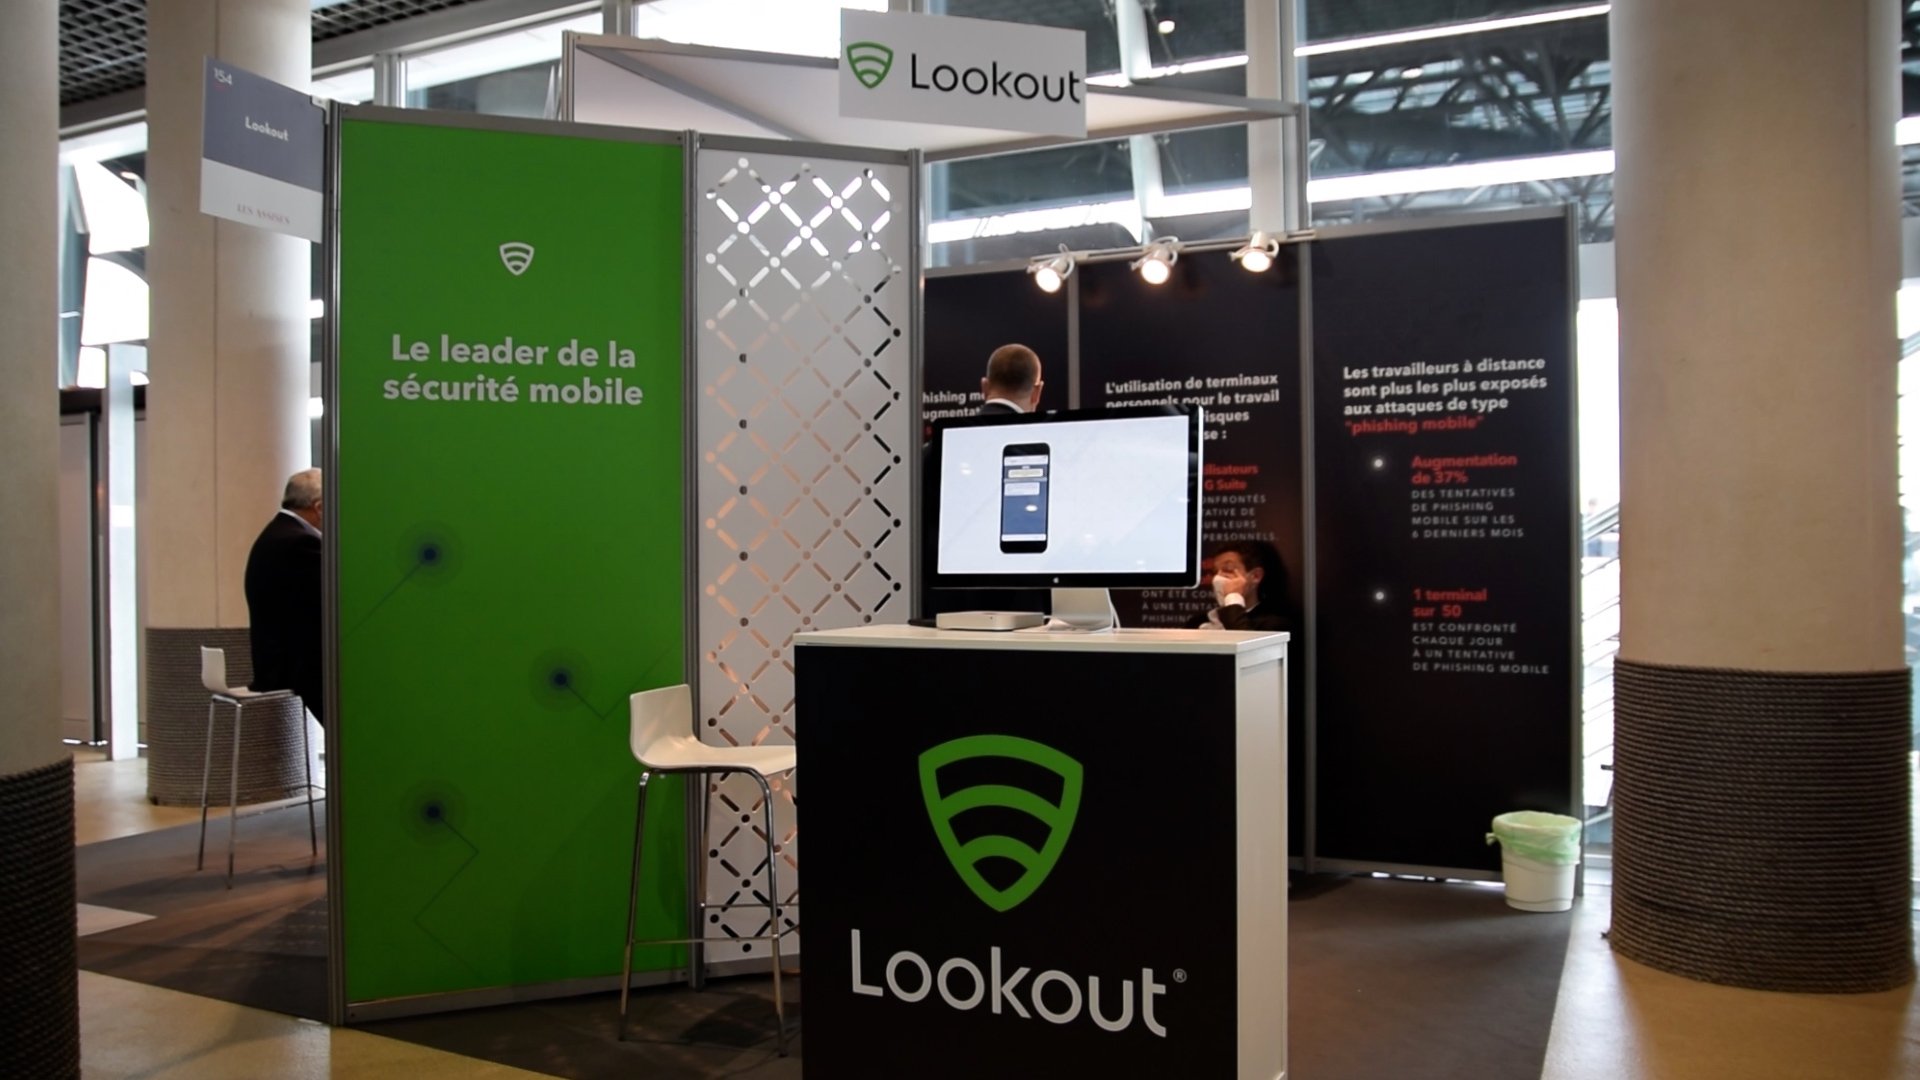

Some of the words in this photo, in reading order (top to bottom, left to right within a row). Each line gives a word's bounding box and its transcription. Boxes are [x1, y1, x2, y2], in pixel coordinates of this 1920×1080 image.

[213, 67, 233, 85] 154
[911, 53, 1081, 104] Lookout
[245, 116, 289, 141] Lookout
[392, 334, 430, 361] Le
[441, 334, 549, 365] leader
[557, 339, 599, 367] de
[609, 340, 636, 368] la
[1343, 366, 1369, 380] Les
[1372, 361, 1460, 378] travailleurs
[1463, 359, 1473, 373] à
[1476, 357, 1546, 372] distance
[383, 373, 519, 402] sécurité
[529, 376, 644, 405] mobile
[1105, 378, 1182, 394] L'utilisation
[1184, 376, 1204, 390] de
[1205, 373, 1279, 388] terminaux
[1343, 384, 1377, 398] sont
[1380, 381, 1413, 399] plus
[1416, 380, 1439, 394] les
[1442, 378, 1477, 396] plus
[1479, 375, 1548, 392] exposés
[922, 390, 967, 405] hishing
[1218, 392, 1232, 405] le
[1234, 389, 1280, 404] travail
[1343, 403, 1372, 415] aux
[1375, 401, 1444, 416] attaques
[1446, 397, 1468, 411] de
[1470, 397, 1509, 413] type
[1205, 411, 1250, 425] isques
[1412, 453, 1518, 471] Augmentation
[1411, 471, 1431, 484] de
[1433, 470, 1468, 484] 37%
[1216, 479, 1247, 491] Suite
[1411, 489, 1435, 499] DES
[1440, 487, 1515, 498] TENTATIVES
[1240, 508, 1256, 517] DE
[1411, 503, 1427, 512] DE
[1433, 501, 1494, 512] PHISHING
[1222, 520, 1257, 529] LEURS
[1411, 516, 1459, 525] MOBILE
[1464, 515, 1488, 525] SUR
[1493, 514, 1515, 524] LES
[1412, 529, 1419, 538] 6
[1423, 528, 1486, 538] DERNIERS
[1491, 528, 1524, 538] MOIS
[1142, 590, 1164, 599] ONT
[1413, 588, 1420, 600] 1
[1425, 587, 1487, 601] terminal
[1153, 602, 1174, 611] UNE
[1413, 605, 1435, 617] sur
[1441, 604, 1462, 617] 50
[1412, 622, 1434, 632] EST
[1438, 622, 1517, 633] CONFRONTÉ
[1412, 636, 1464, 646] CHAQUE
[1470, 637, 1503, 646] JOUR
[1412, 648, 1421, 657] À
[1425, 650, 1442, 658] UN
[1447, 650, 1515, 660] TENTATIVE
[1412, 662, 1428, 671] DE
[1433, 662, 1494, 673] PHISHING
[1499, 664, 1549, 674] MOBILE
[851, 929, 1167, 1038] Lookout
